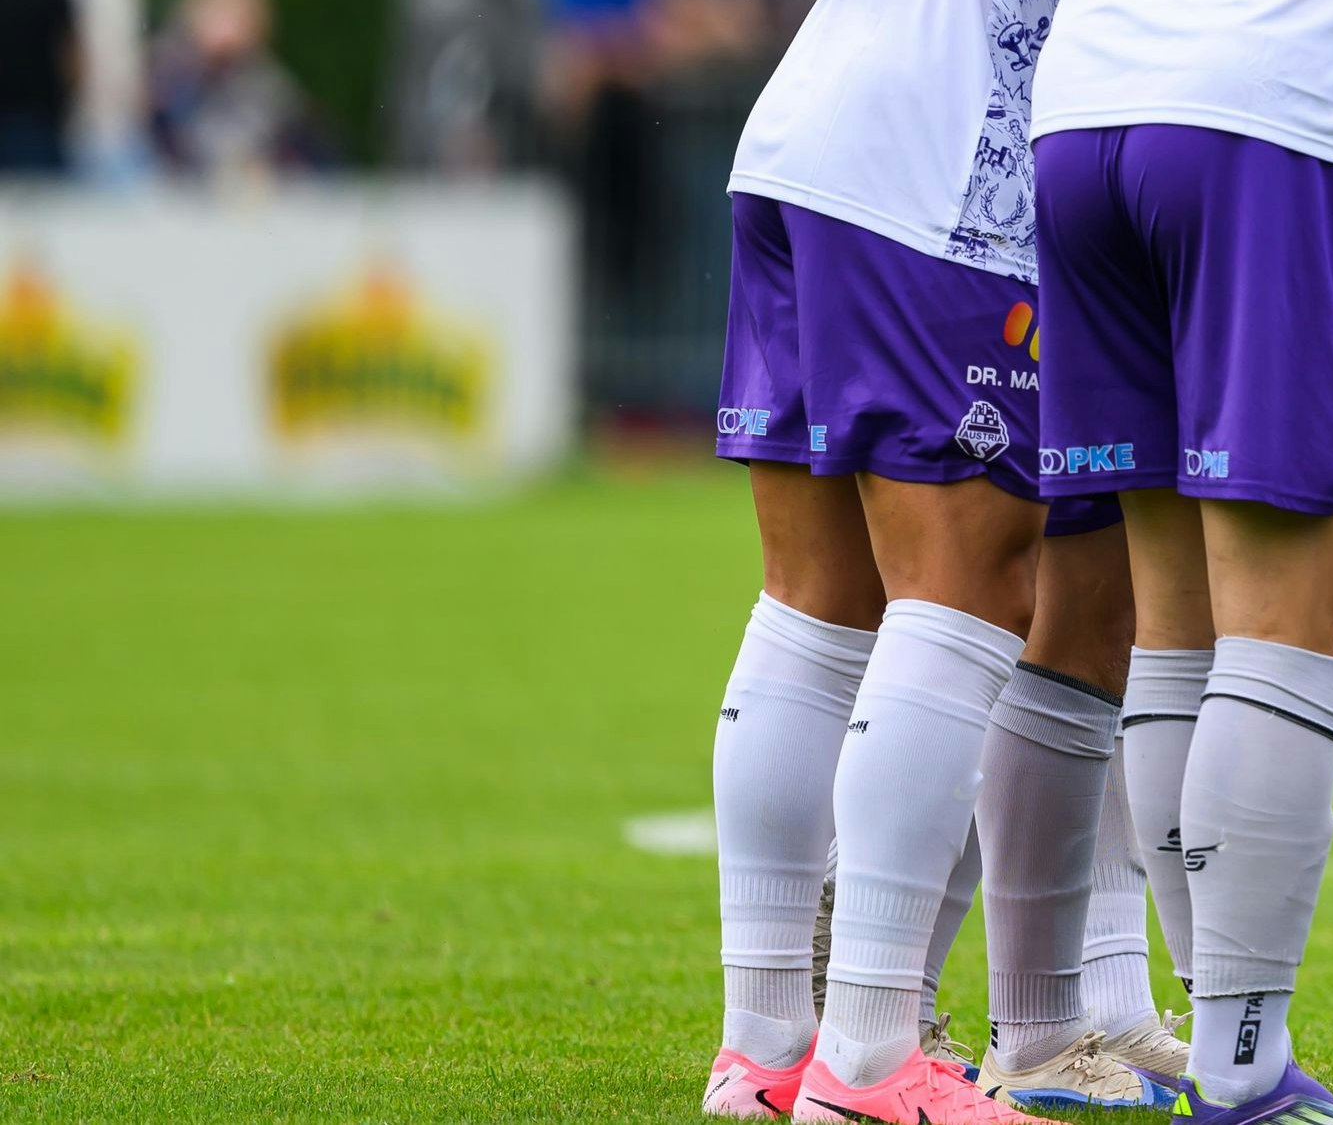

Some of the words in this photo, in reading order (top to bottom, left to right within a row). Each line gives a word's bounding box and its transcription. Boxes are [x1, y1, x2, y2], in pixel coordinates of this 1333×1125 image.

[966, 365, 1003, 387] DR.
[1010, 370, 1040, 391] MA
[960, 430, 1005, 443] AUSTRIA
[1066, 443, 1136, 475] PKE
